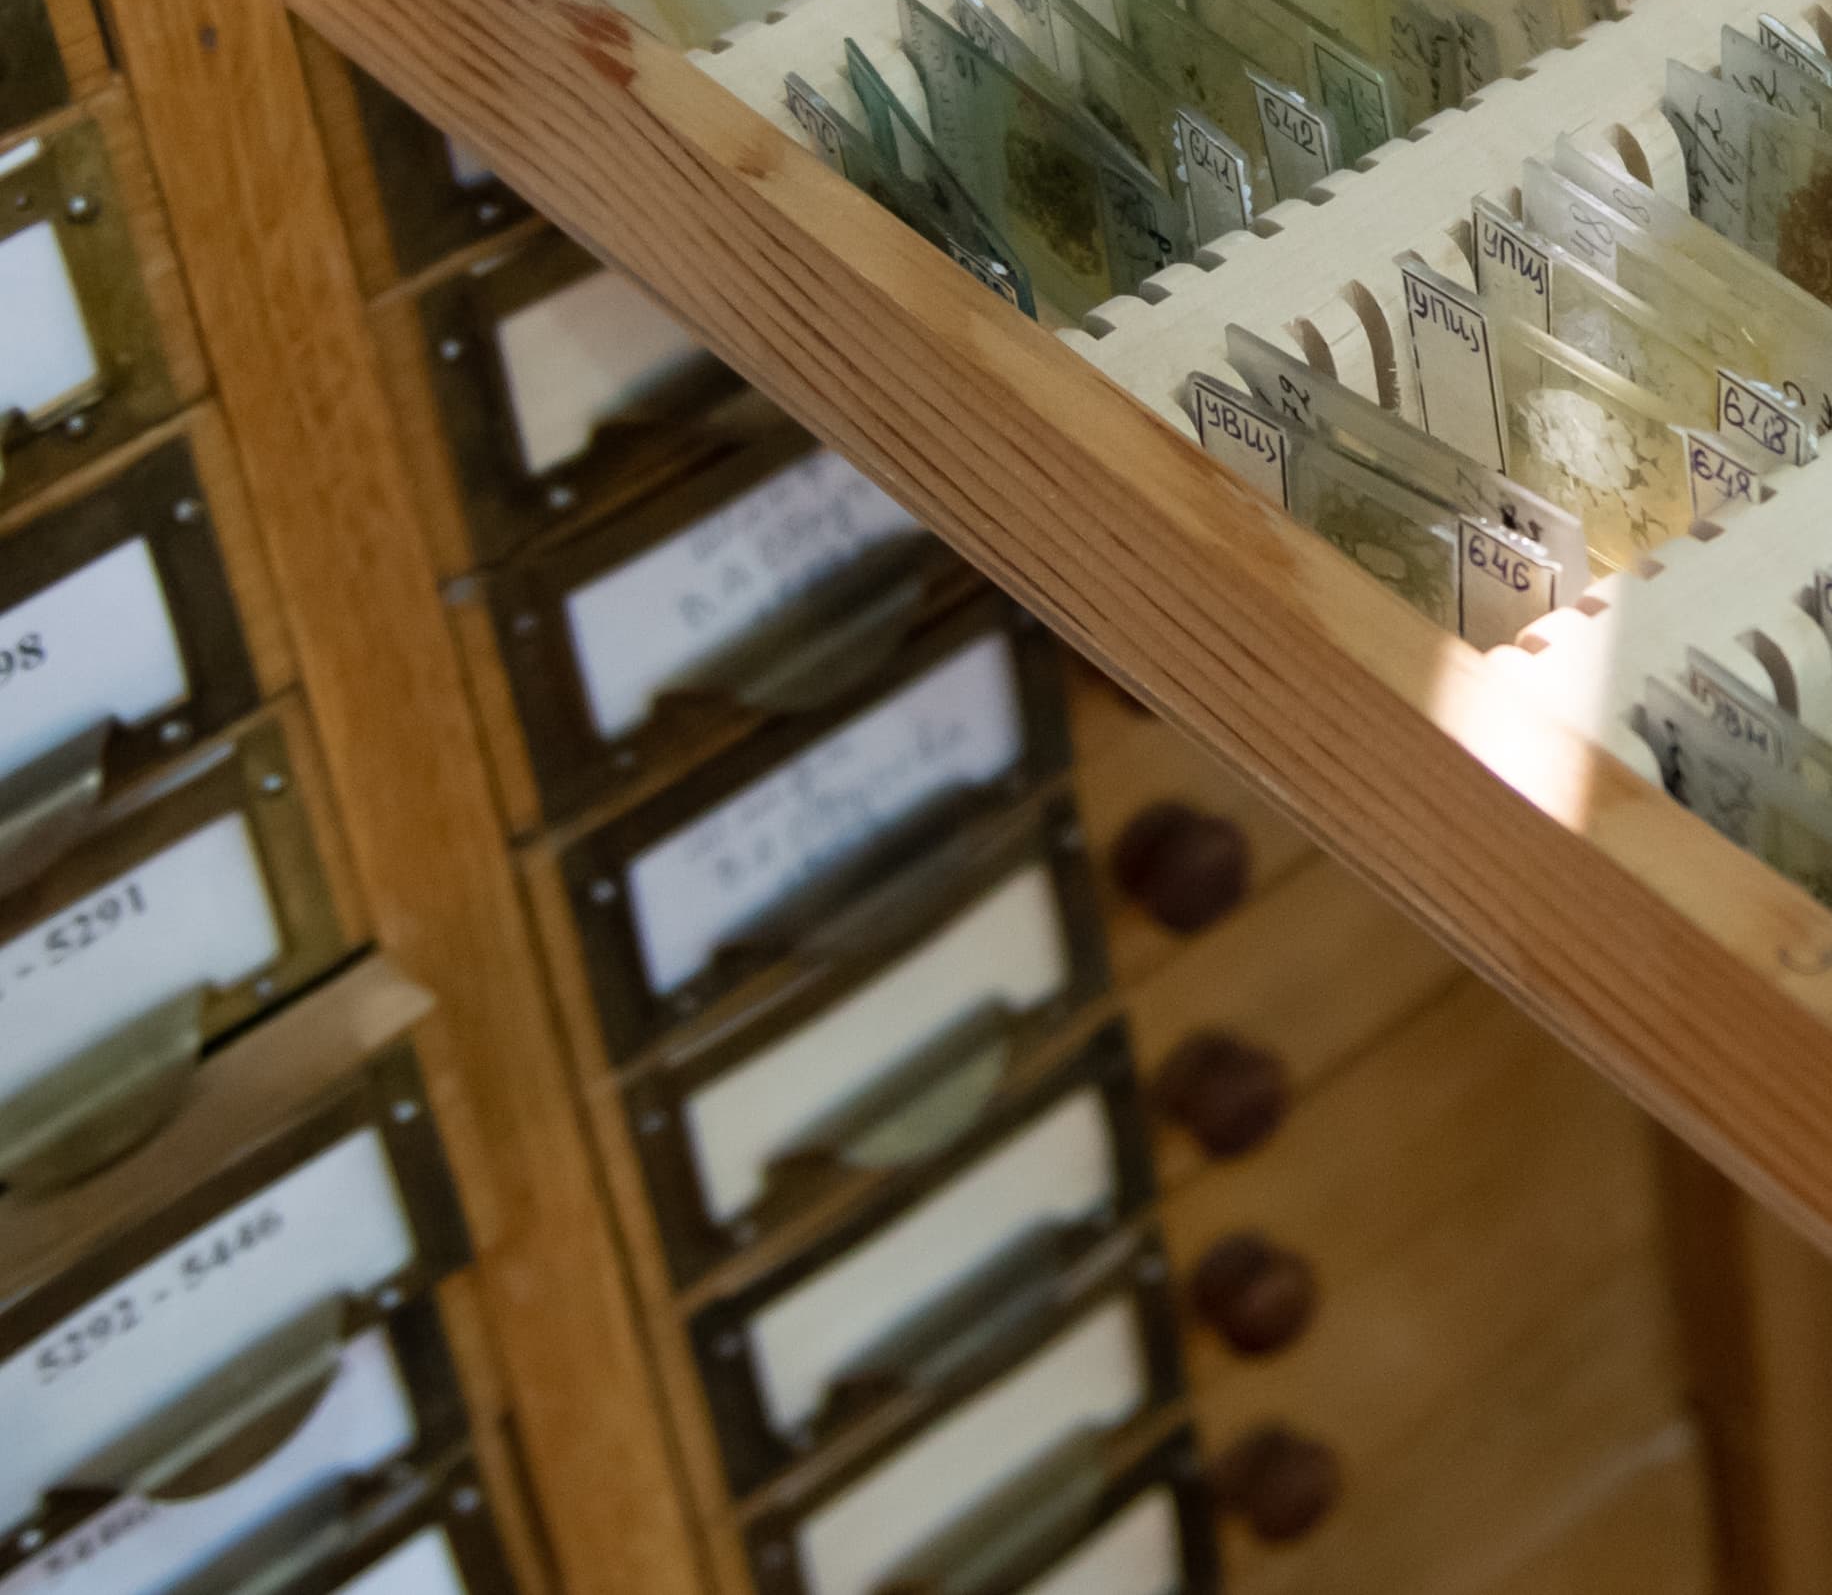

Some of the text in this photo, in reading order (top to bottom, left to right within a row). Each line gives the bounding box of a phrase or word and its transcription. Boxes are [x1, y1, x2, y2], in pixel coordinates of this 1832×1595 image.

[1263, 97, 1314, 148] 642
[1468, 534, 1531, 593] 646
[44, 884, 148, 966] 5291
